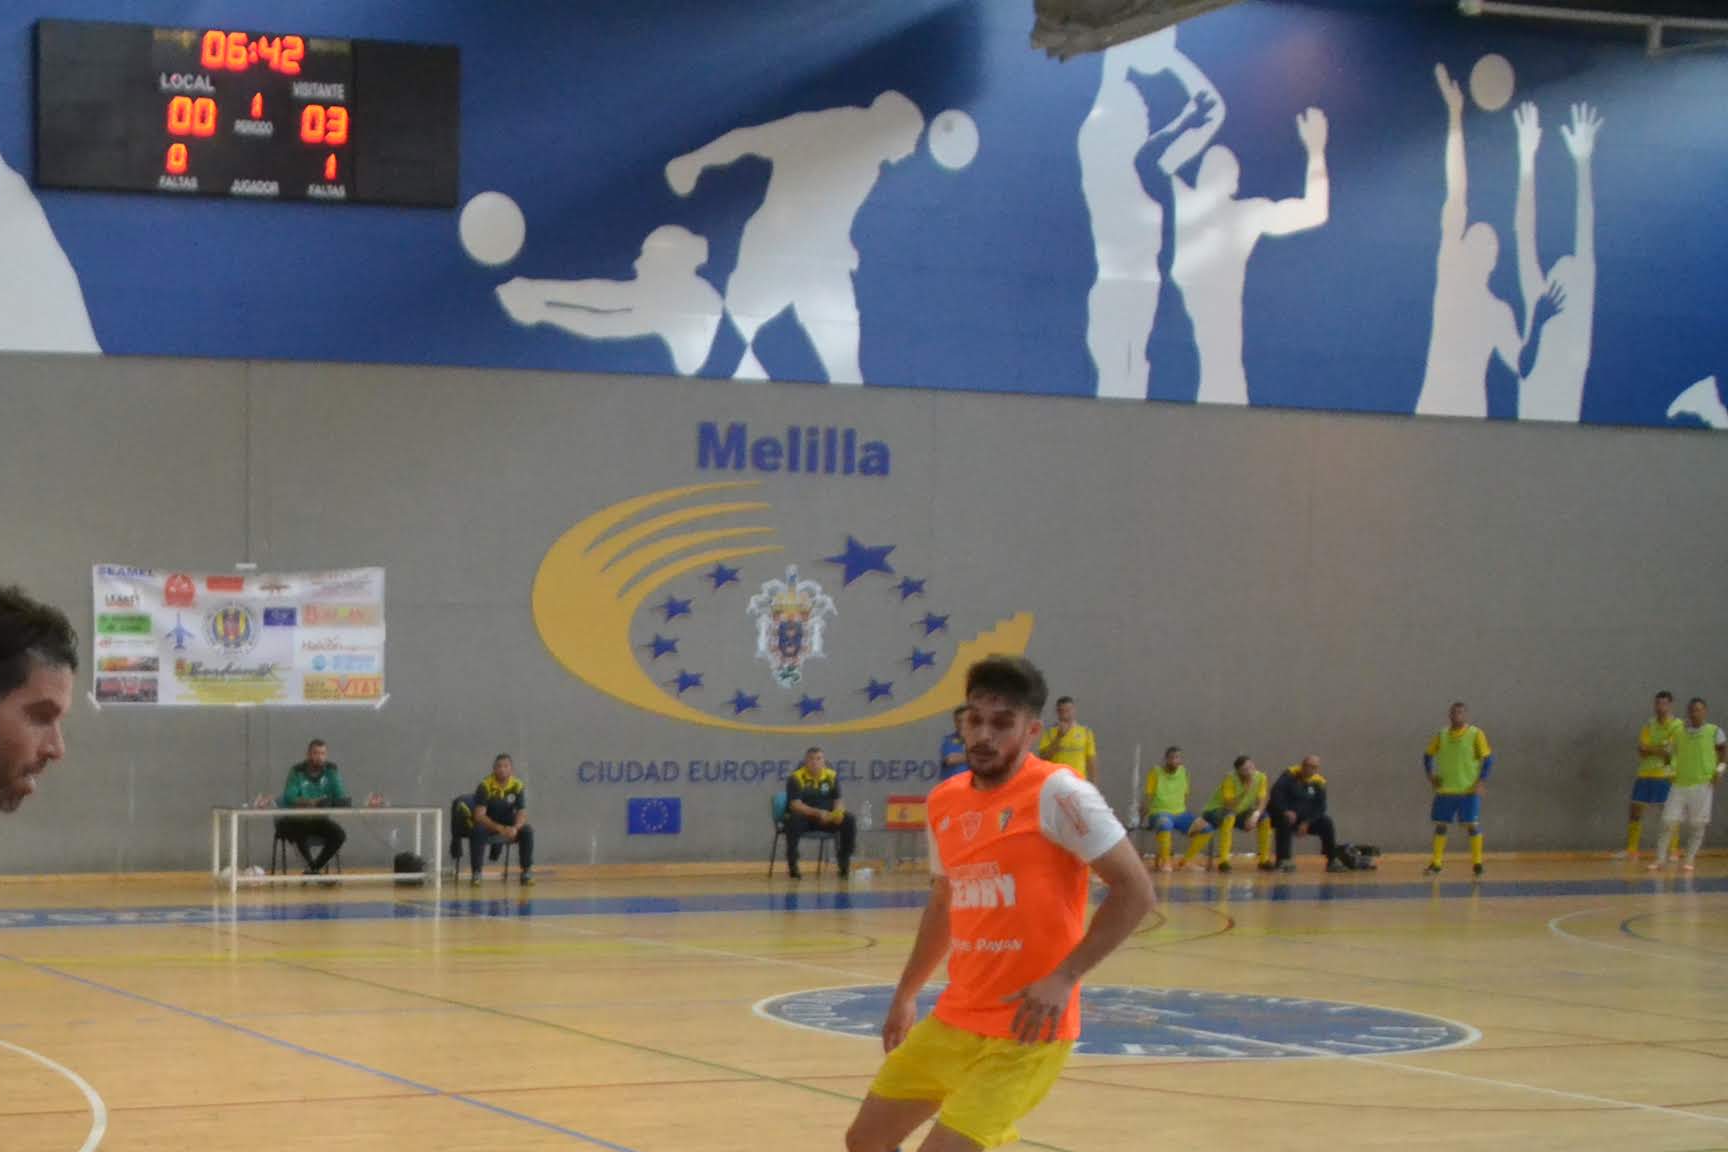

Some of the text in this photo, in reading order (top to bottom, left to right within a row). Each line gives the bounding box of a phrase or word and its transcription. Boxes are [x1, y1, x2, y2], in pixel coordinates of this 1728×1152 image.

[201, 30, 305, 75] 06:42
[160, 73, 215, 91] LOCAL
[292, 81, 345, 99] VISITANTE
[167, 96, 218, 136] 00
[250, 91, 263, 118] 1
[300, 104, 349, 144] 03
[166, 143, 188, 174] 0
[324, 153, 337, 180] 1
[159, 175, 198, 191] FALTAS
[231, 179, 279, 196] JUGADOR
[307, 184, 346, 199] FALTAS
[696, 421, 891, 476] Melilla
[577, 760, 680, 784] CIUDAD
[689, 760, 808, 784] EUROPE
[828, 760, 864, 783] EL
